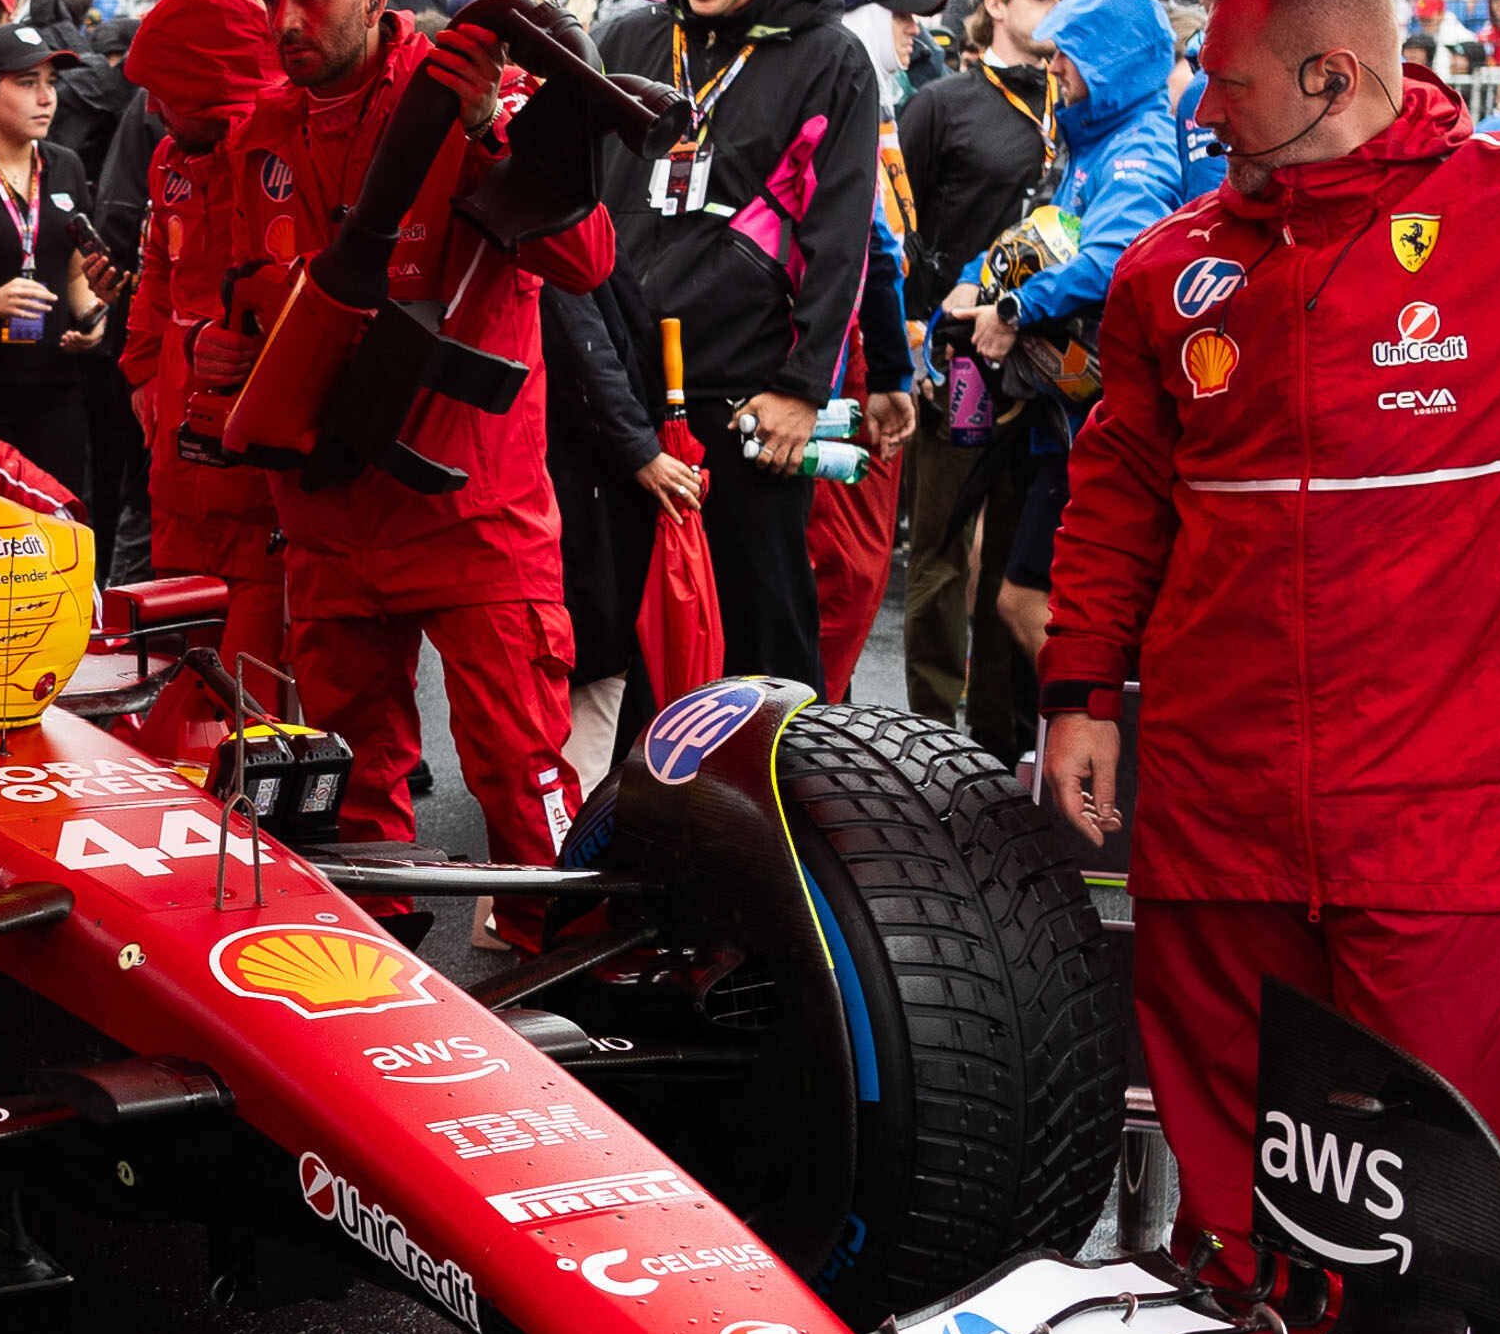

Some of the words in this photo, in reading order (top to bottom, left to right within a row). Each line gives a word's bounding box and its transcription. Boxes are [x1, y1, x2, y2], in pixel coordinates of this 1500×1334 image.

[1177, 257, 1243, 317] hp
[1375, 338, 1466, 364] UniCredit
[650, 681, 762, 785] hp
[55, 810, 276, 878] 44
[363, 1036, 489, 1072] aws
[425, 1104, 609, 1160] IBM
[1261, 1111, 1404, 1220] aws
[485, 1170, 704, 1224] PIRELLI
[336, 1176, 482, 1334] UniCredit
